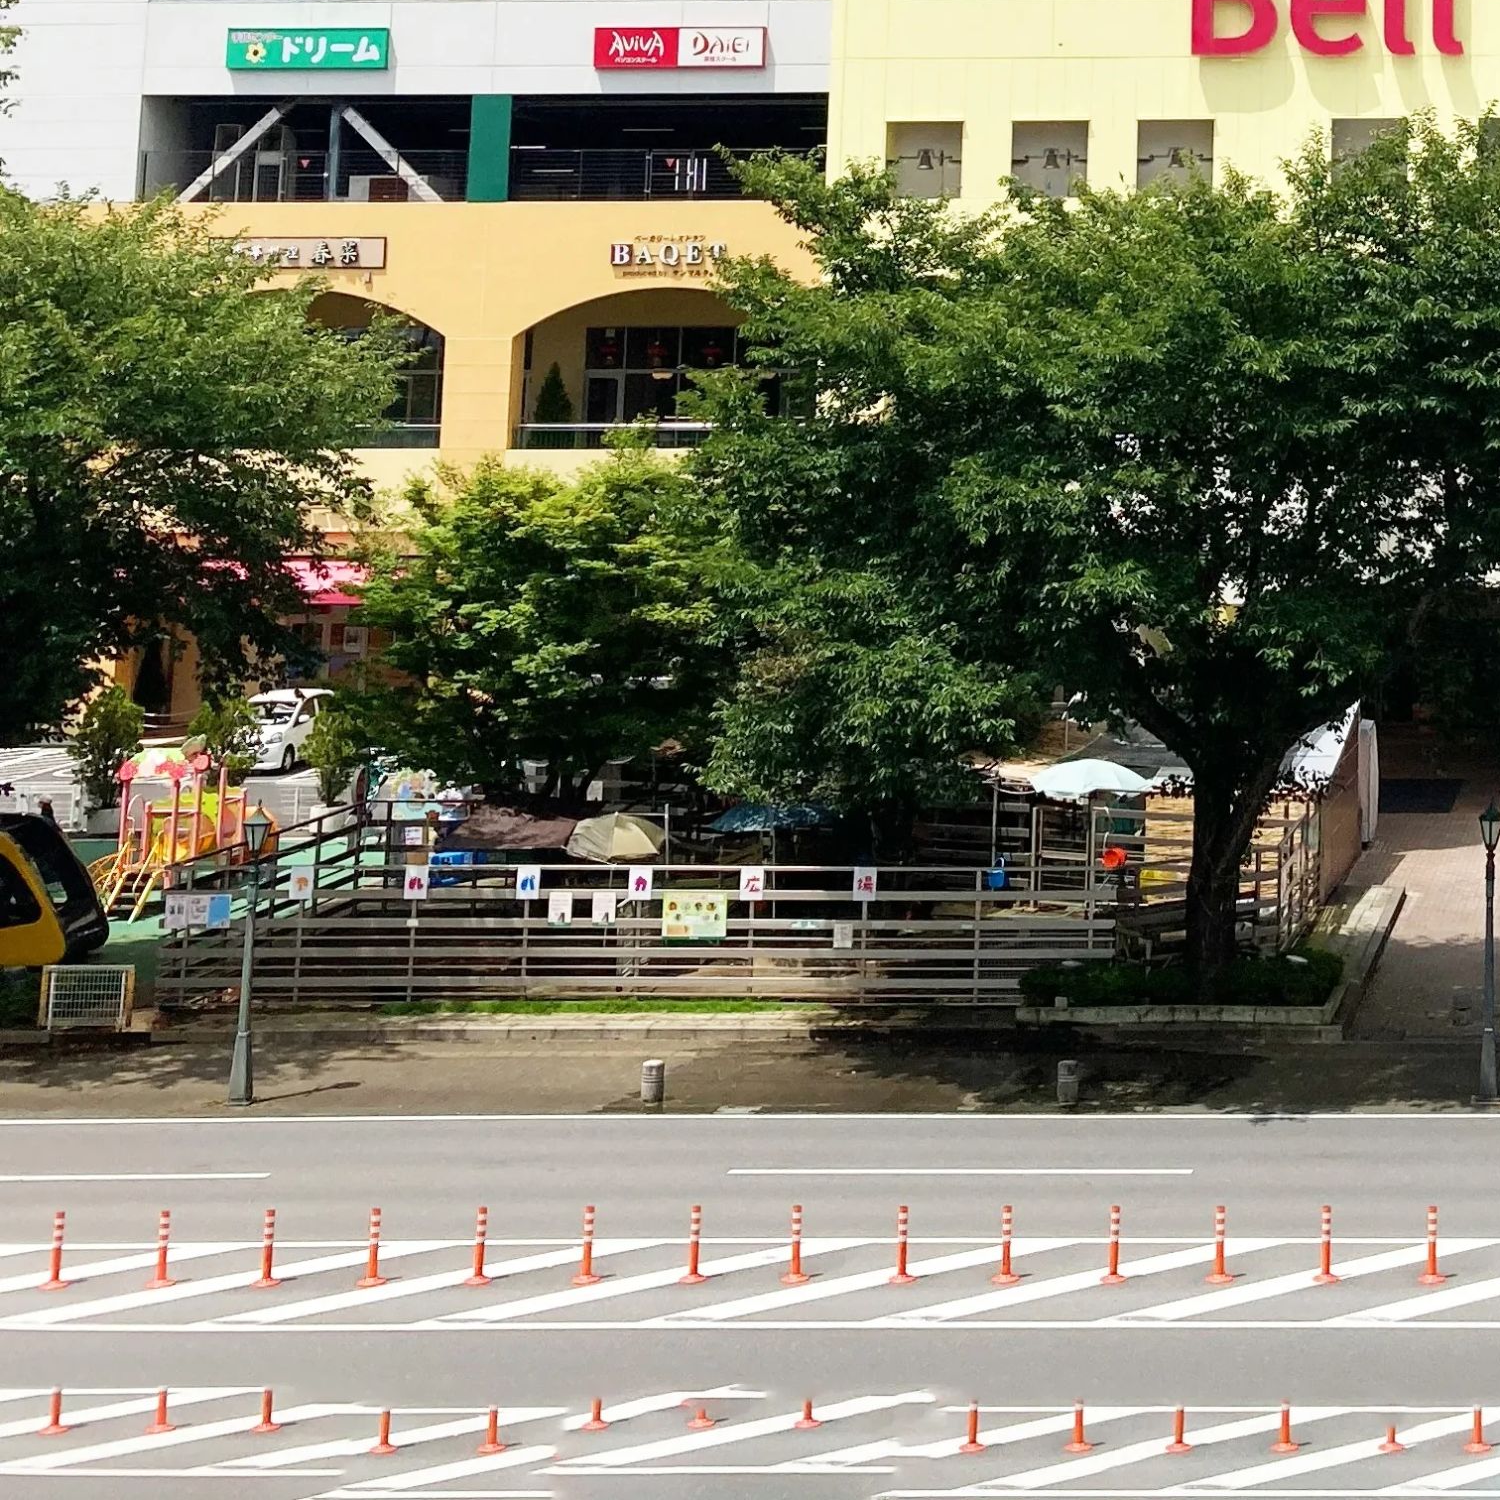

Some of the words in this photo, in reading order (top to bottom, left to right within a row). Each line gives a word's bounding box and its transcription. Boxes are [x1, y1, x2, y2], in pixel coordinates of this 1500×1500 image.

[282, 36, 380, 63] ドリーム
[612, 243, 727, 266] BAQET
